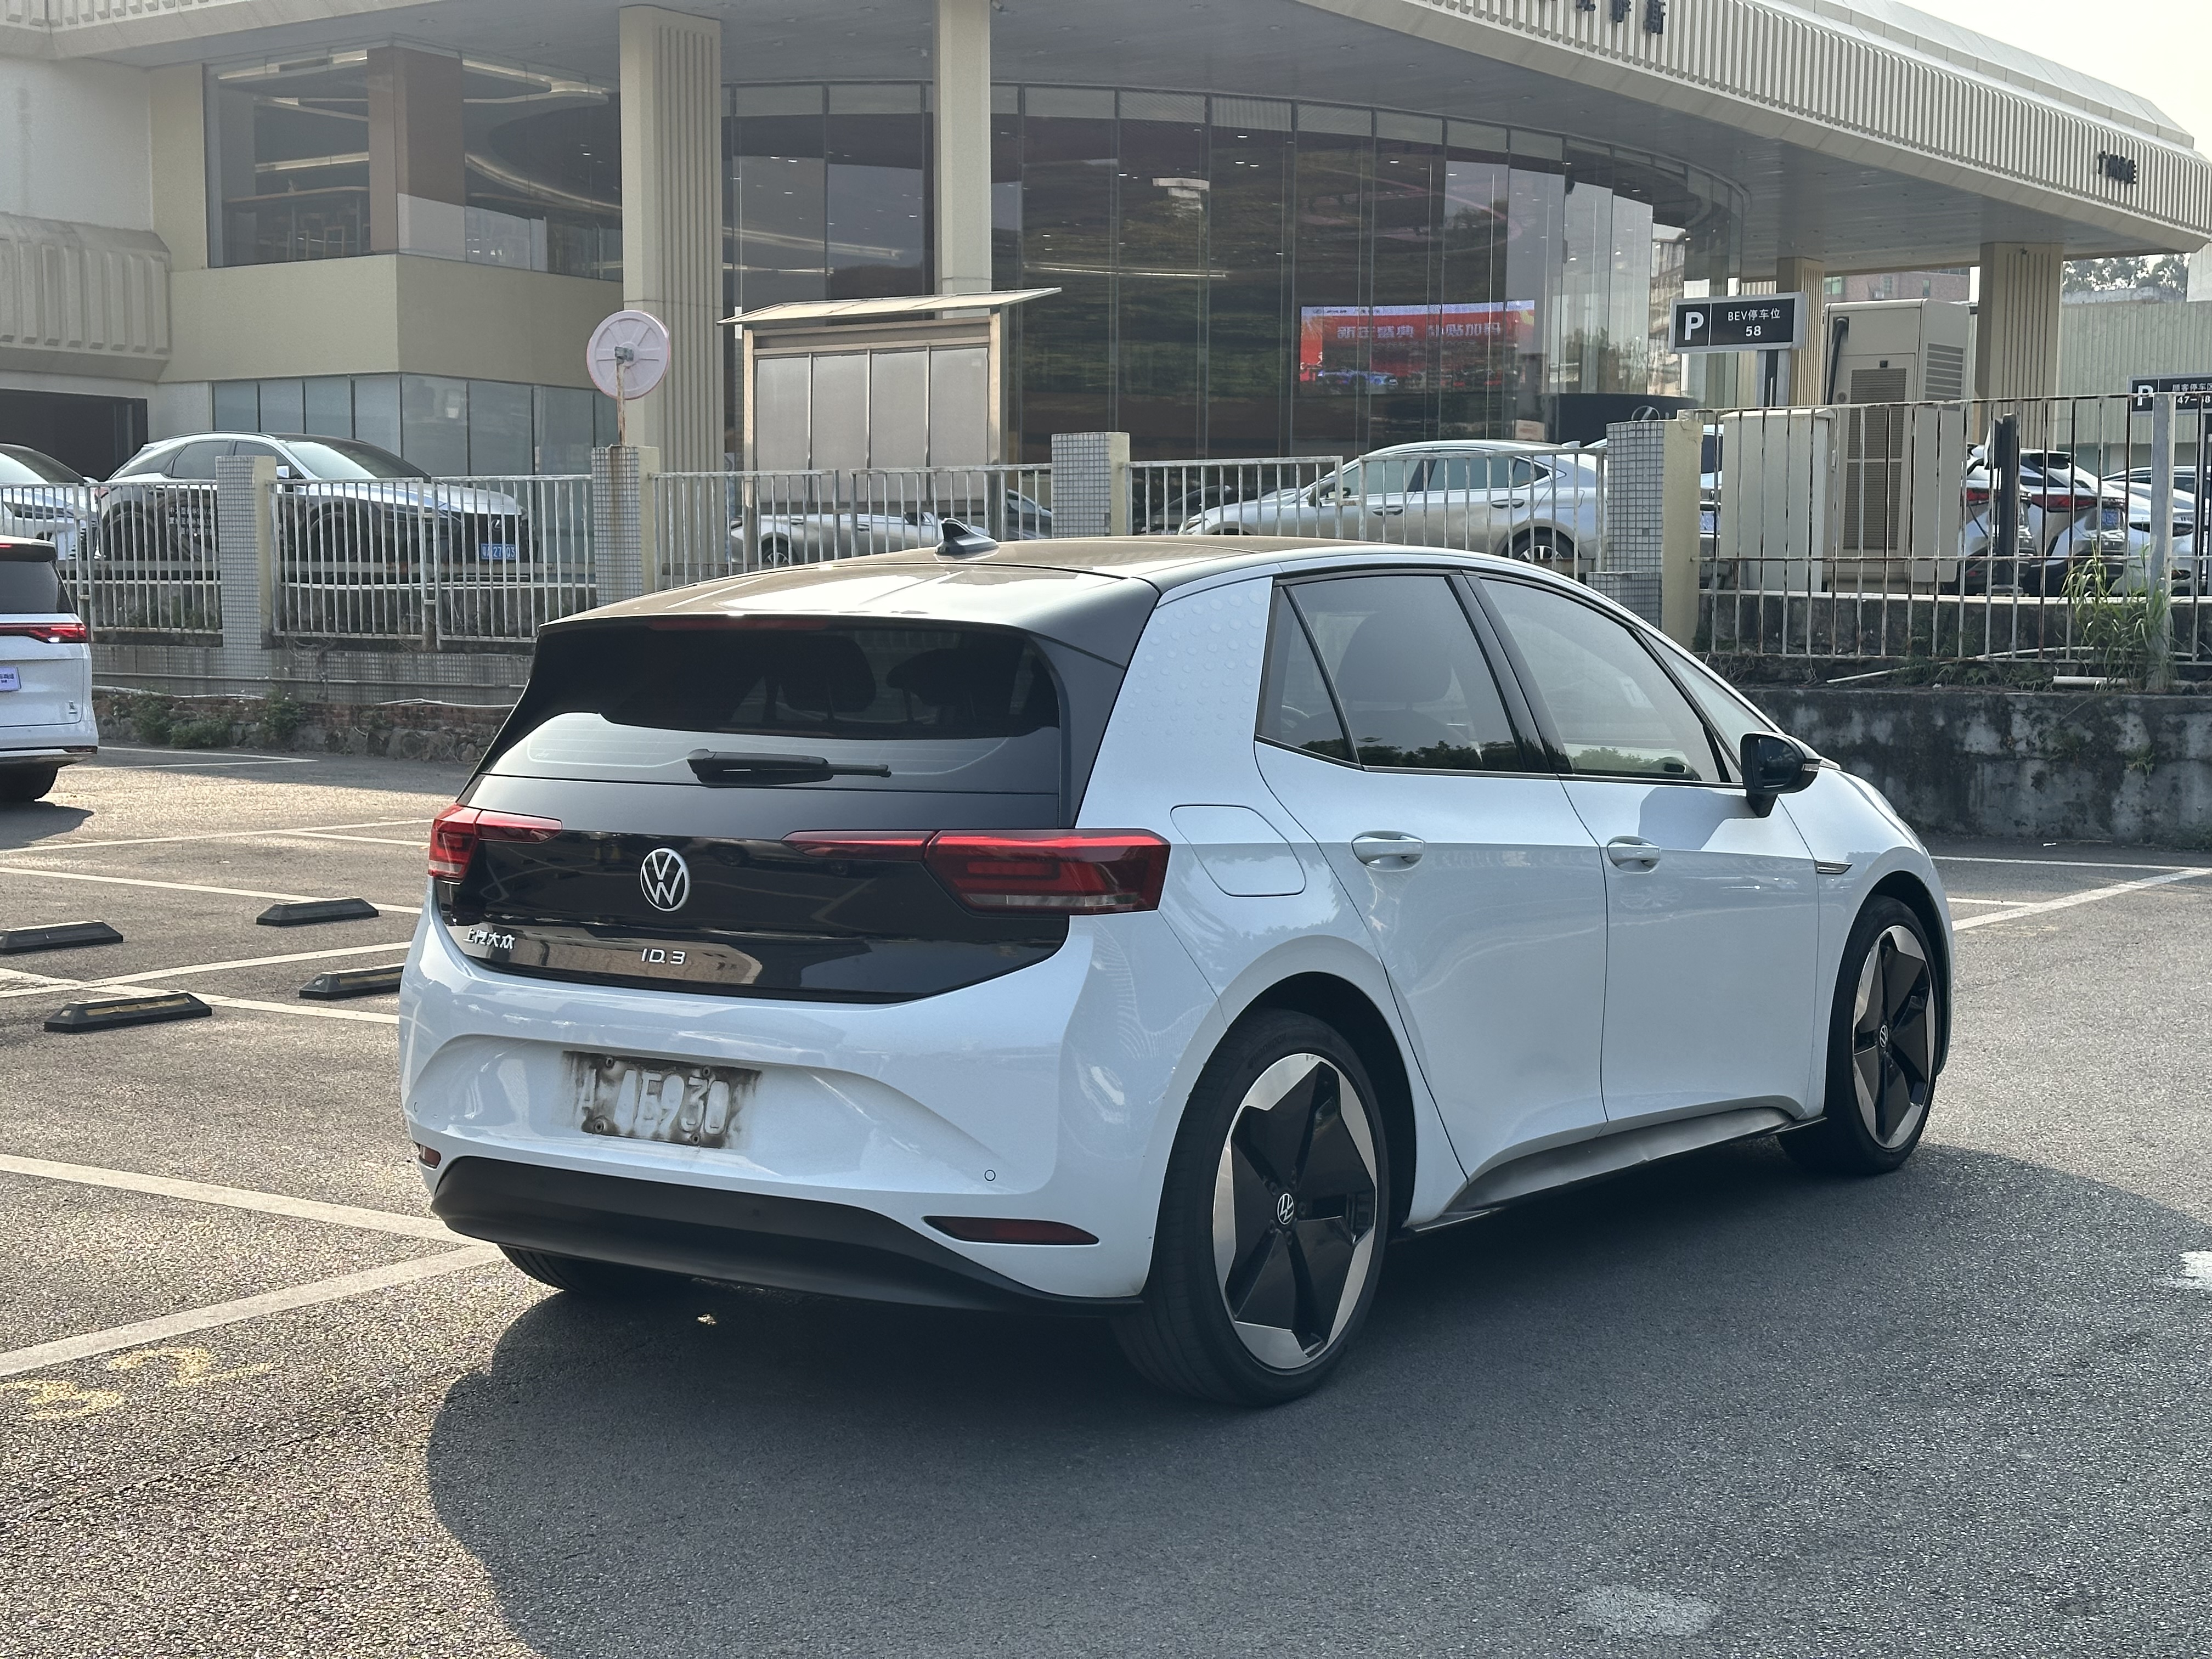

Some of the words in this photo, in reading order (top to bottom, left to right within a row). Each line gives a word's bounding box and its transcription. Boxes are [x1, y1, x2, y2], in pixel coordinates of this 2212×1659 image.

[1728, 308, 1780, 321] BEV停车位
[1684, 311, 1704, 340] P
[1746, 325, 1761, 336] 58
[462, 928, 515, 950] 上汽大众
